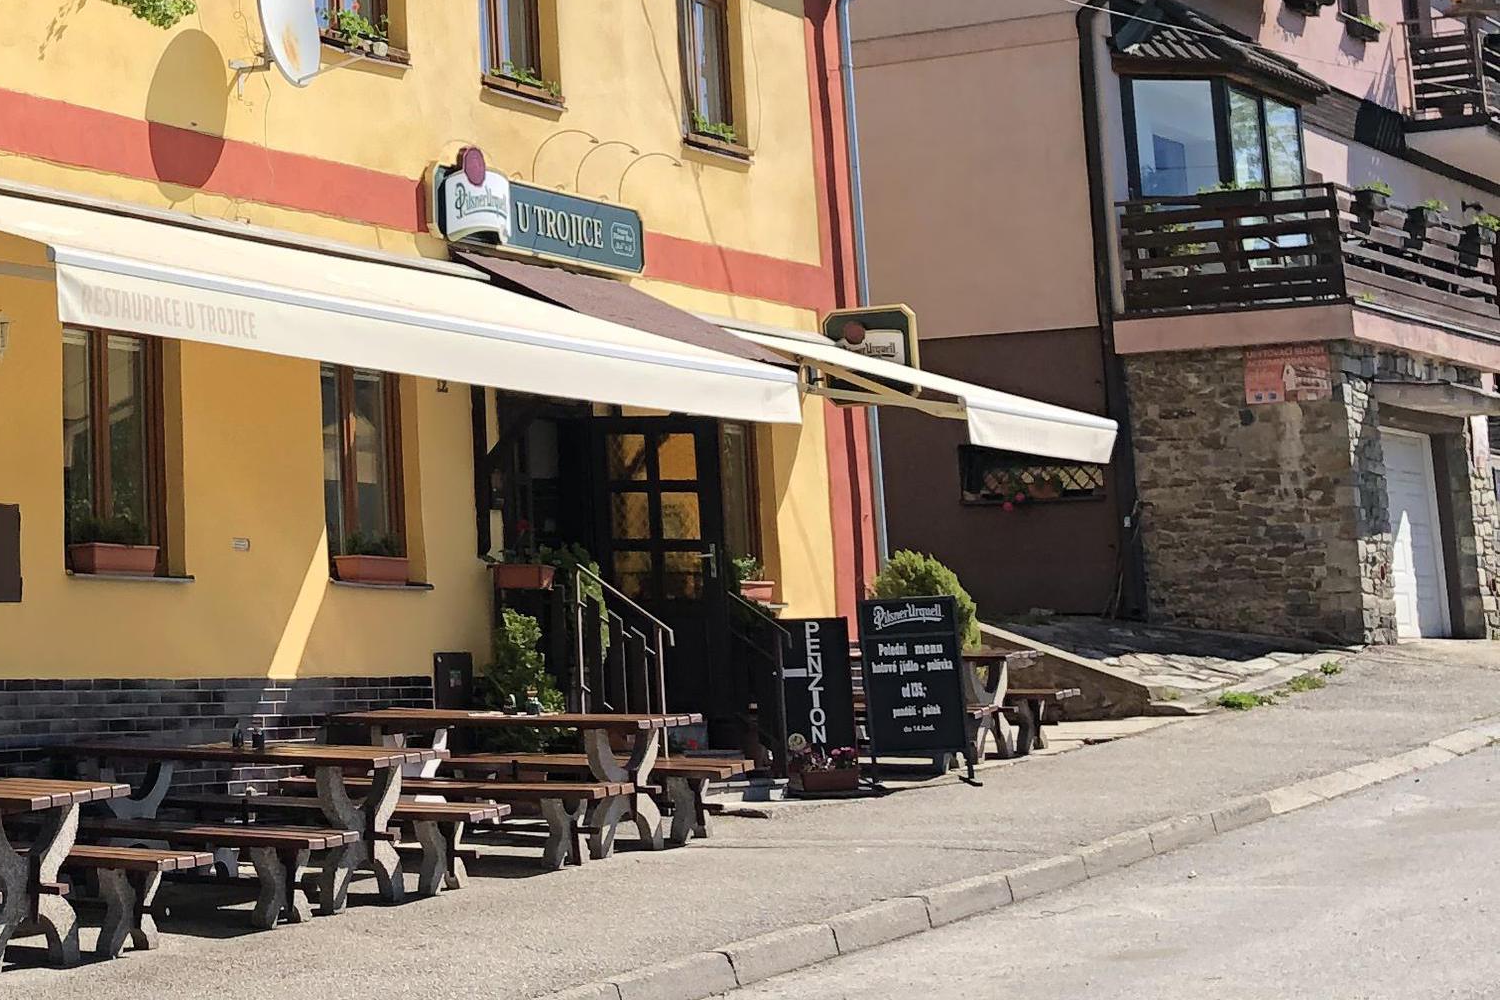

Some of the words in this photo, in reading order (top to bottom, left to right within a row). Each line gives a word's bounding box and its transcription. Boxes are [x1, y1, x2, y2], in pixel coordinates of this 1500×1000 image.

[516, 201, 530, 233] U
[533, 205, 604, 249] TROJICE
[81, 284, 181, 327] RESTAURACE
[185, 301, 196, 330] U
[199, 303, 258, 339] TROJICE
[873, 605, 908, 631] Pilsner
[905, 603, 943, 623] Urquell
[914, 643, 944, 655] menu
[804, 621, 827, 744] PENZION
[901, 682, 911, 698] od
